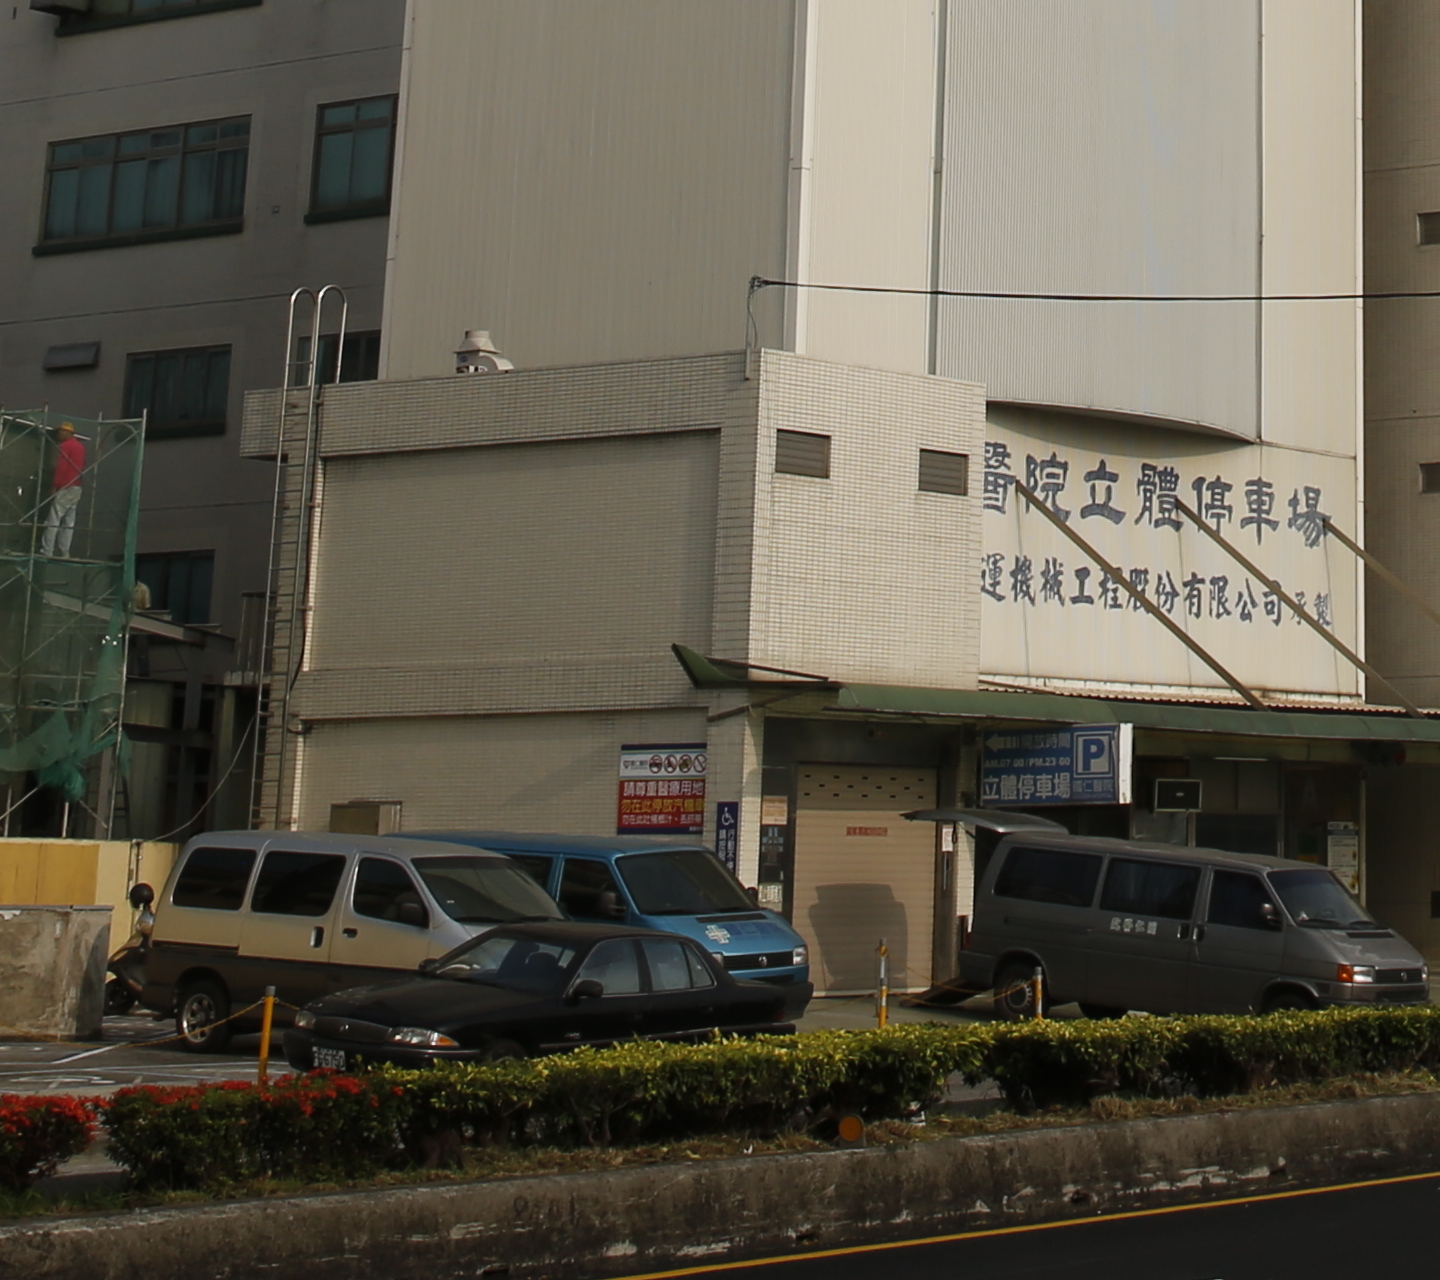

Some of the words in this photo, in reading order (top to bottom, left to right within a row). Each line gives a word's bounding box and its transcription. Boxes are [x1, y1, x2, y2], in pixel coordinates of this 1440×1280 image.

[1082, 738, 1105, 772] P
[983, 772, 1071, 800] 立體停車場
